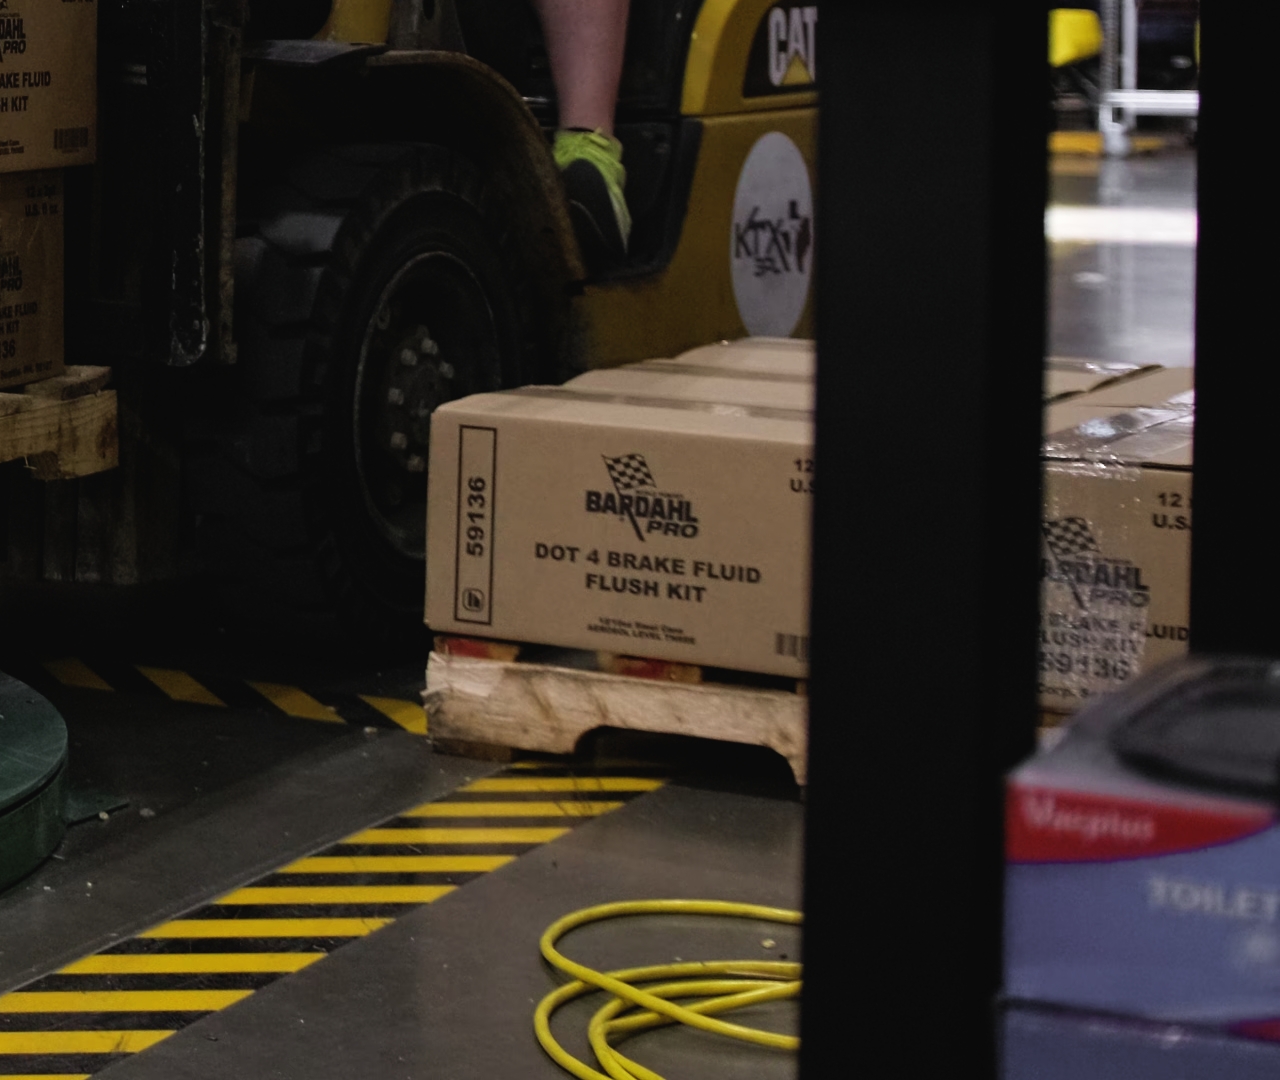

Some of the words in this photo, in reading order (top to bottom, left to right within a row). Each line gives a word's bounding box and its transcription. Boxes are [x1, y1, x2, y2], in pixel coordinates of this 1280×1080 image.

[3, 40, 25, 52] PRO
[768, 6, 818, 87] CAT
[467, 477, 484, 556] 59136
[586, 491, 698, 522] BARDAHL
[647, 520, 699, 538] PRO
[534, 541, 578, 561] DOT
[585, 547, 597, 563] 4
[606, 550, 683, 574] BRAKE
[692, 560, 762, 583] FLUID
[585, 572, 657, 596] FLUSH
[666, 582, 705, 602] KIT
